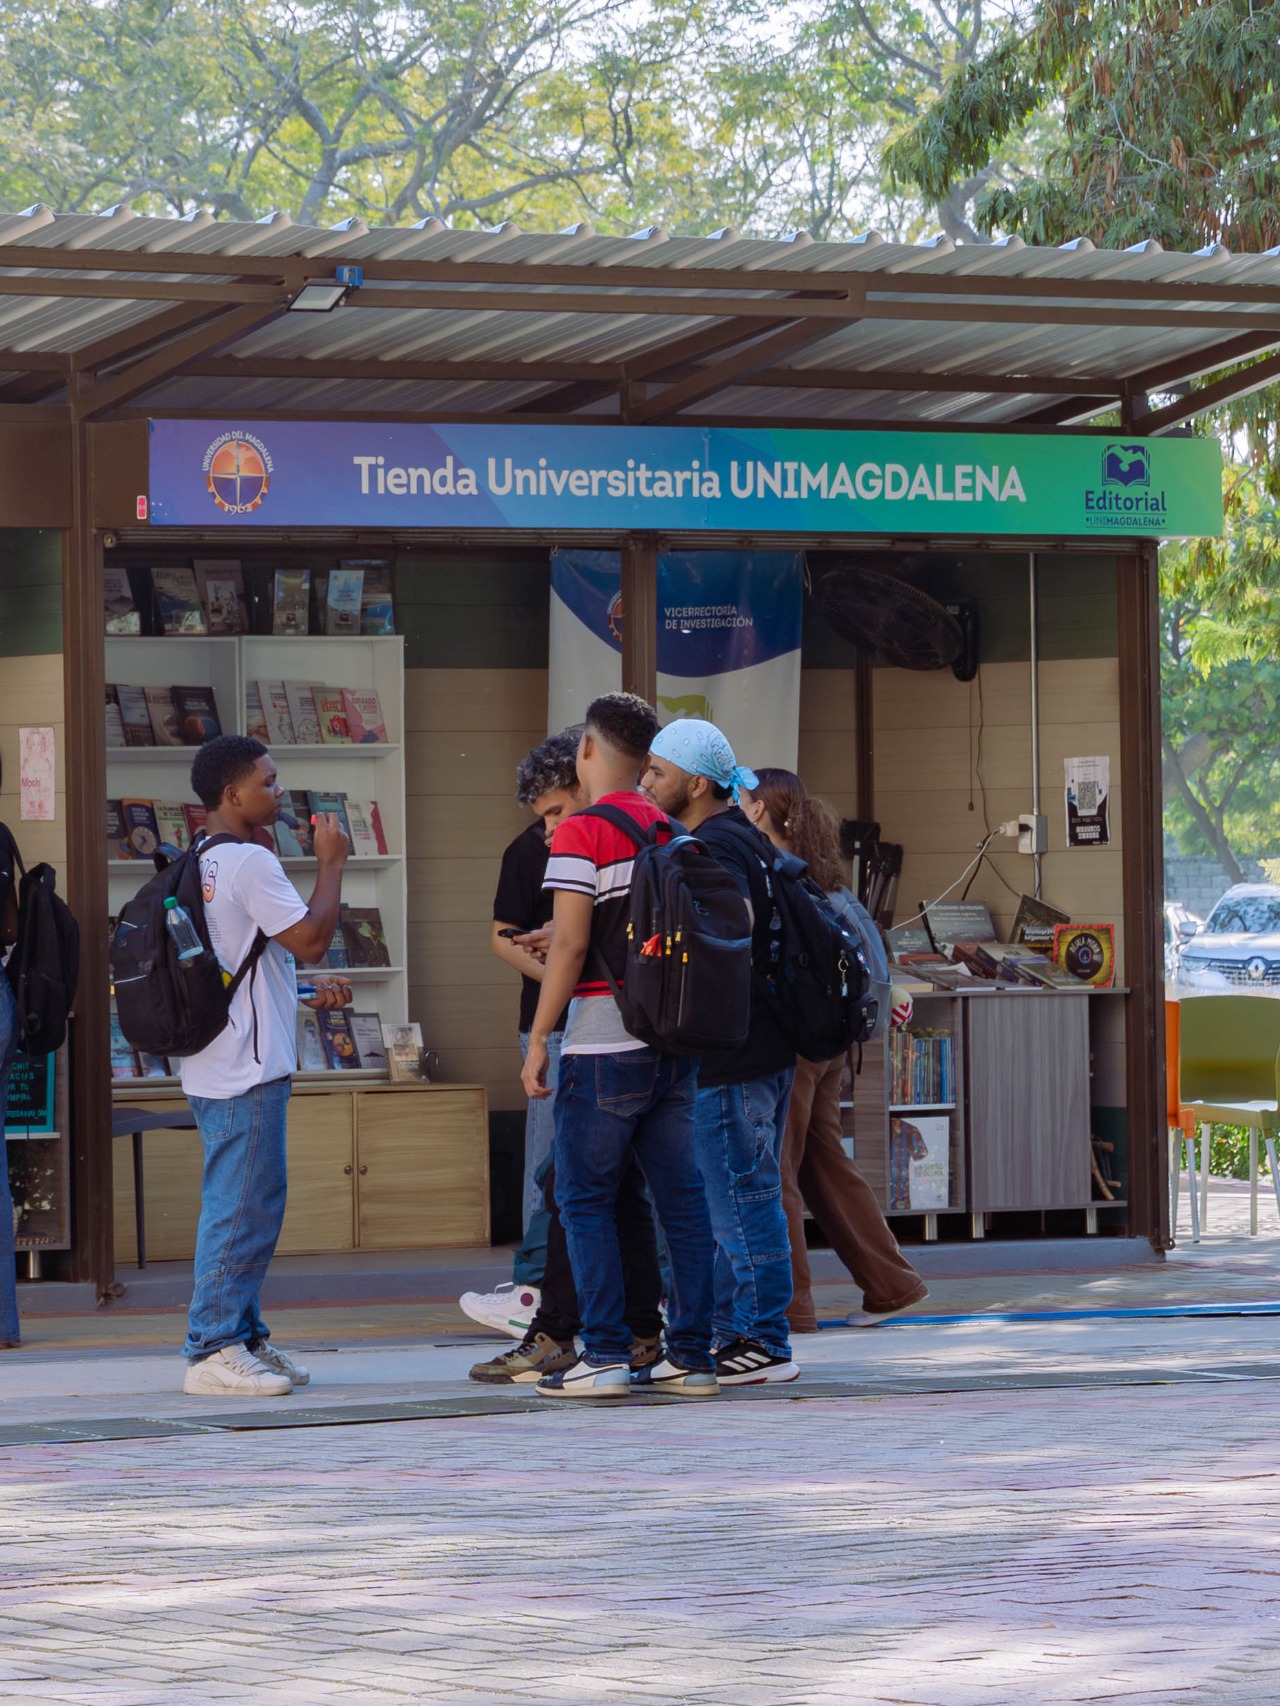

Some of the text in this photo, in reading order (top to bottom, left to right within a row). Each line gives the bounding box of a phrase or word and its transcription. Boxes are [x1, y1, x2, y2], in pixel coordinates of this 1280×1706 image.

[202, 430, 274, 474] UNIVERSIDAD DEL MAGDALENA
[353, 456, 1027, 502] Tienda Universitaria UNIMAGDALENA
[1085, 489, 1167, 512] Editorial
[664, 604, 738, 617] VICERRECTORÍA
[665, 615, 754, 629] DE INVESTIGACIÓN
